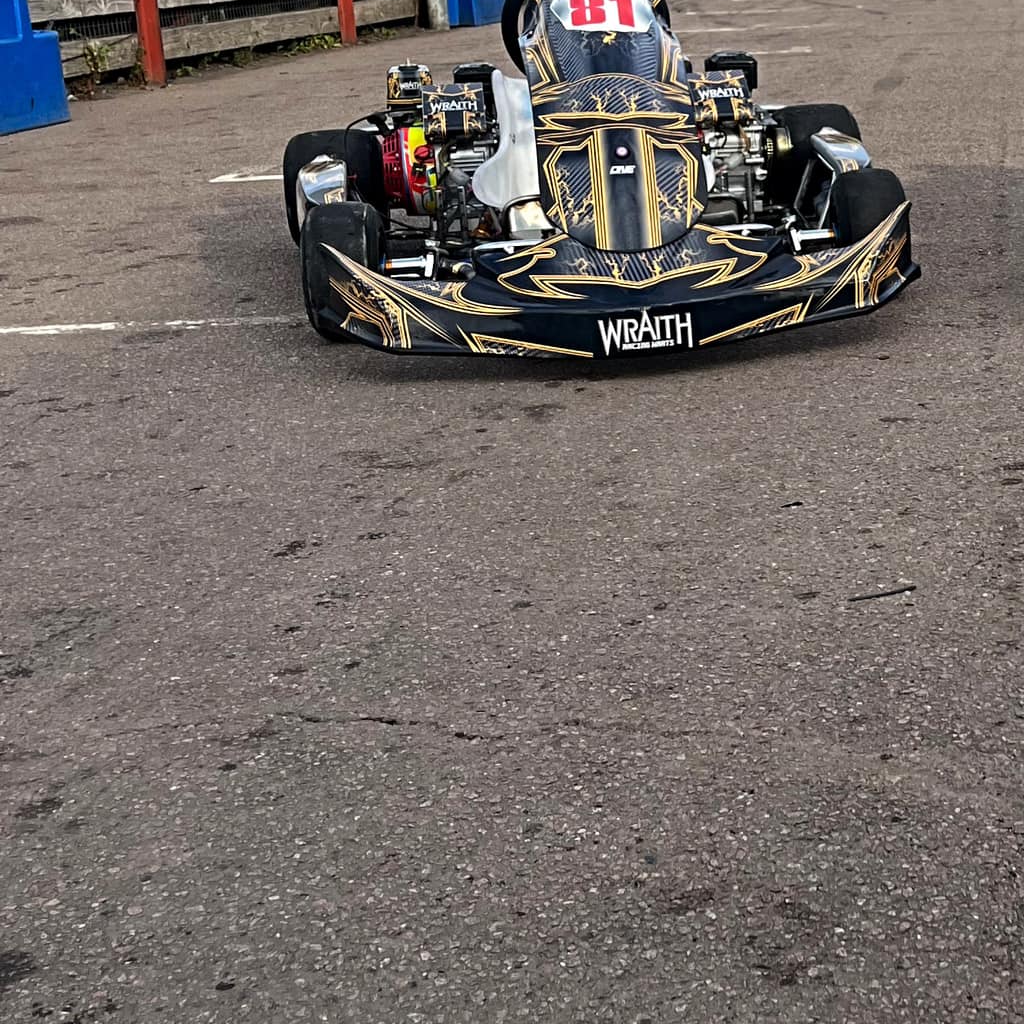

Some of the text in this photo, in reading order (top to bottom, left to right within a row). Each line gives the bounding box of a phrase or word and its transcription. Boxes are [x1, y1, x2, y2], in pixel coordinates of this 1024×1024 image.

[697, 87, 744, 102] WRAITH
[429, 99, 478, 114] WRAITH
[597, 309, 694, 356] WRAITH
